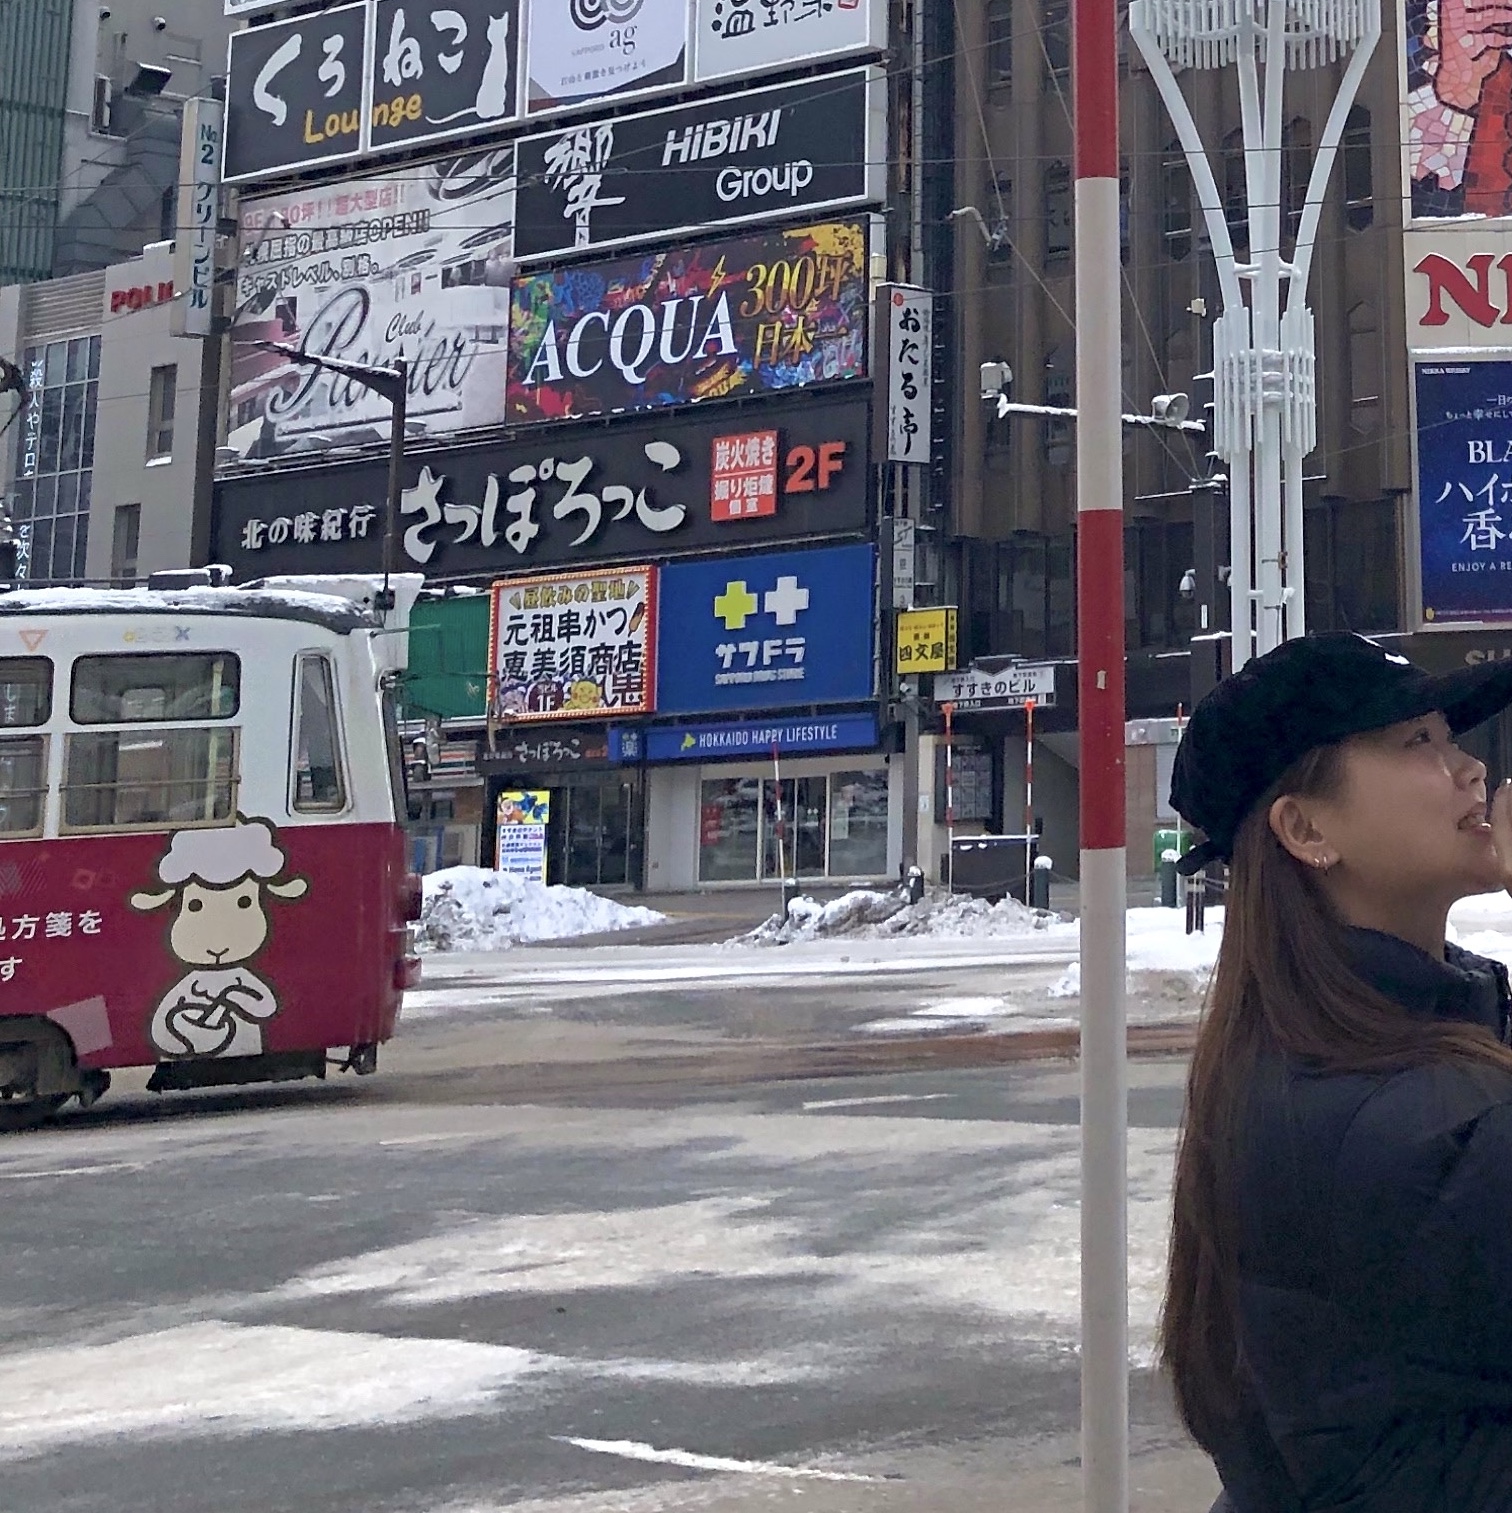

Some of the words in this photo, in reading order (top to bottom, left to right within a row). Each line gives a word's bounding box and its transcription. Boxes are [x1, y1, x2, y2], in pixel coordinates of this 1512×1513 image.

[609, 25, 638, 56] ag
[252, 8, 470, 127] くろねこ
[303, 92, 424, 145] Lounge
[716, 159, 814, 203] Group
[386, 309, 425, 344] Club
[523, 290, 739, 385] ACQUA
[714, 435, 777, 472] 炭火焼き
[784, 440, 847, 494] 2F
[401, 441, 688, 565] さっぽろっこ
[728, 496, 760, 516] 個室
[241, 503, 378, 550] 北の味紀行
[1451, 561, 1485, 573] ENJOY
[1488, 561, 1498, 572] A
[502, 606, 629, 647] 元祖串かつ
[501, 639, 644, 683] 恵美須商店
[952, 679, 1037, 699] すすきのビル
[699, 731, 749, 748] HOKKAIDO
[752, 727, 784, 745] HAPPY
[786, 724, 839, 743] LIFESTYLE
[0, 909, 103, 941] 方箋を
